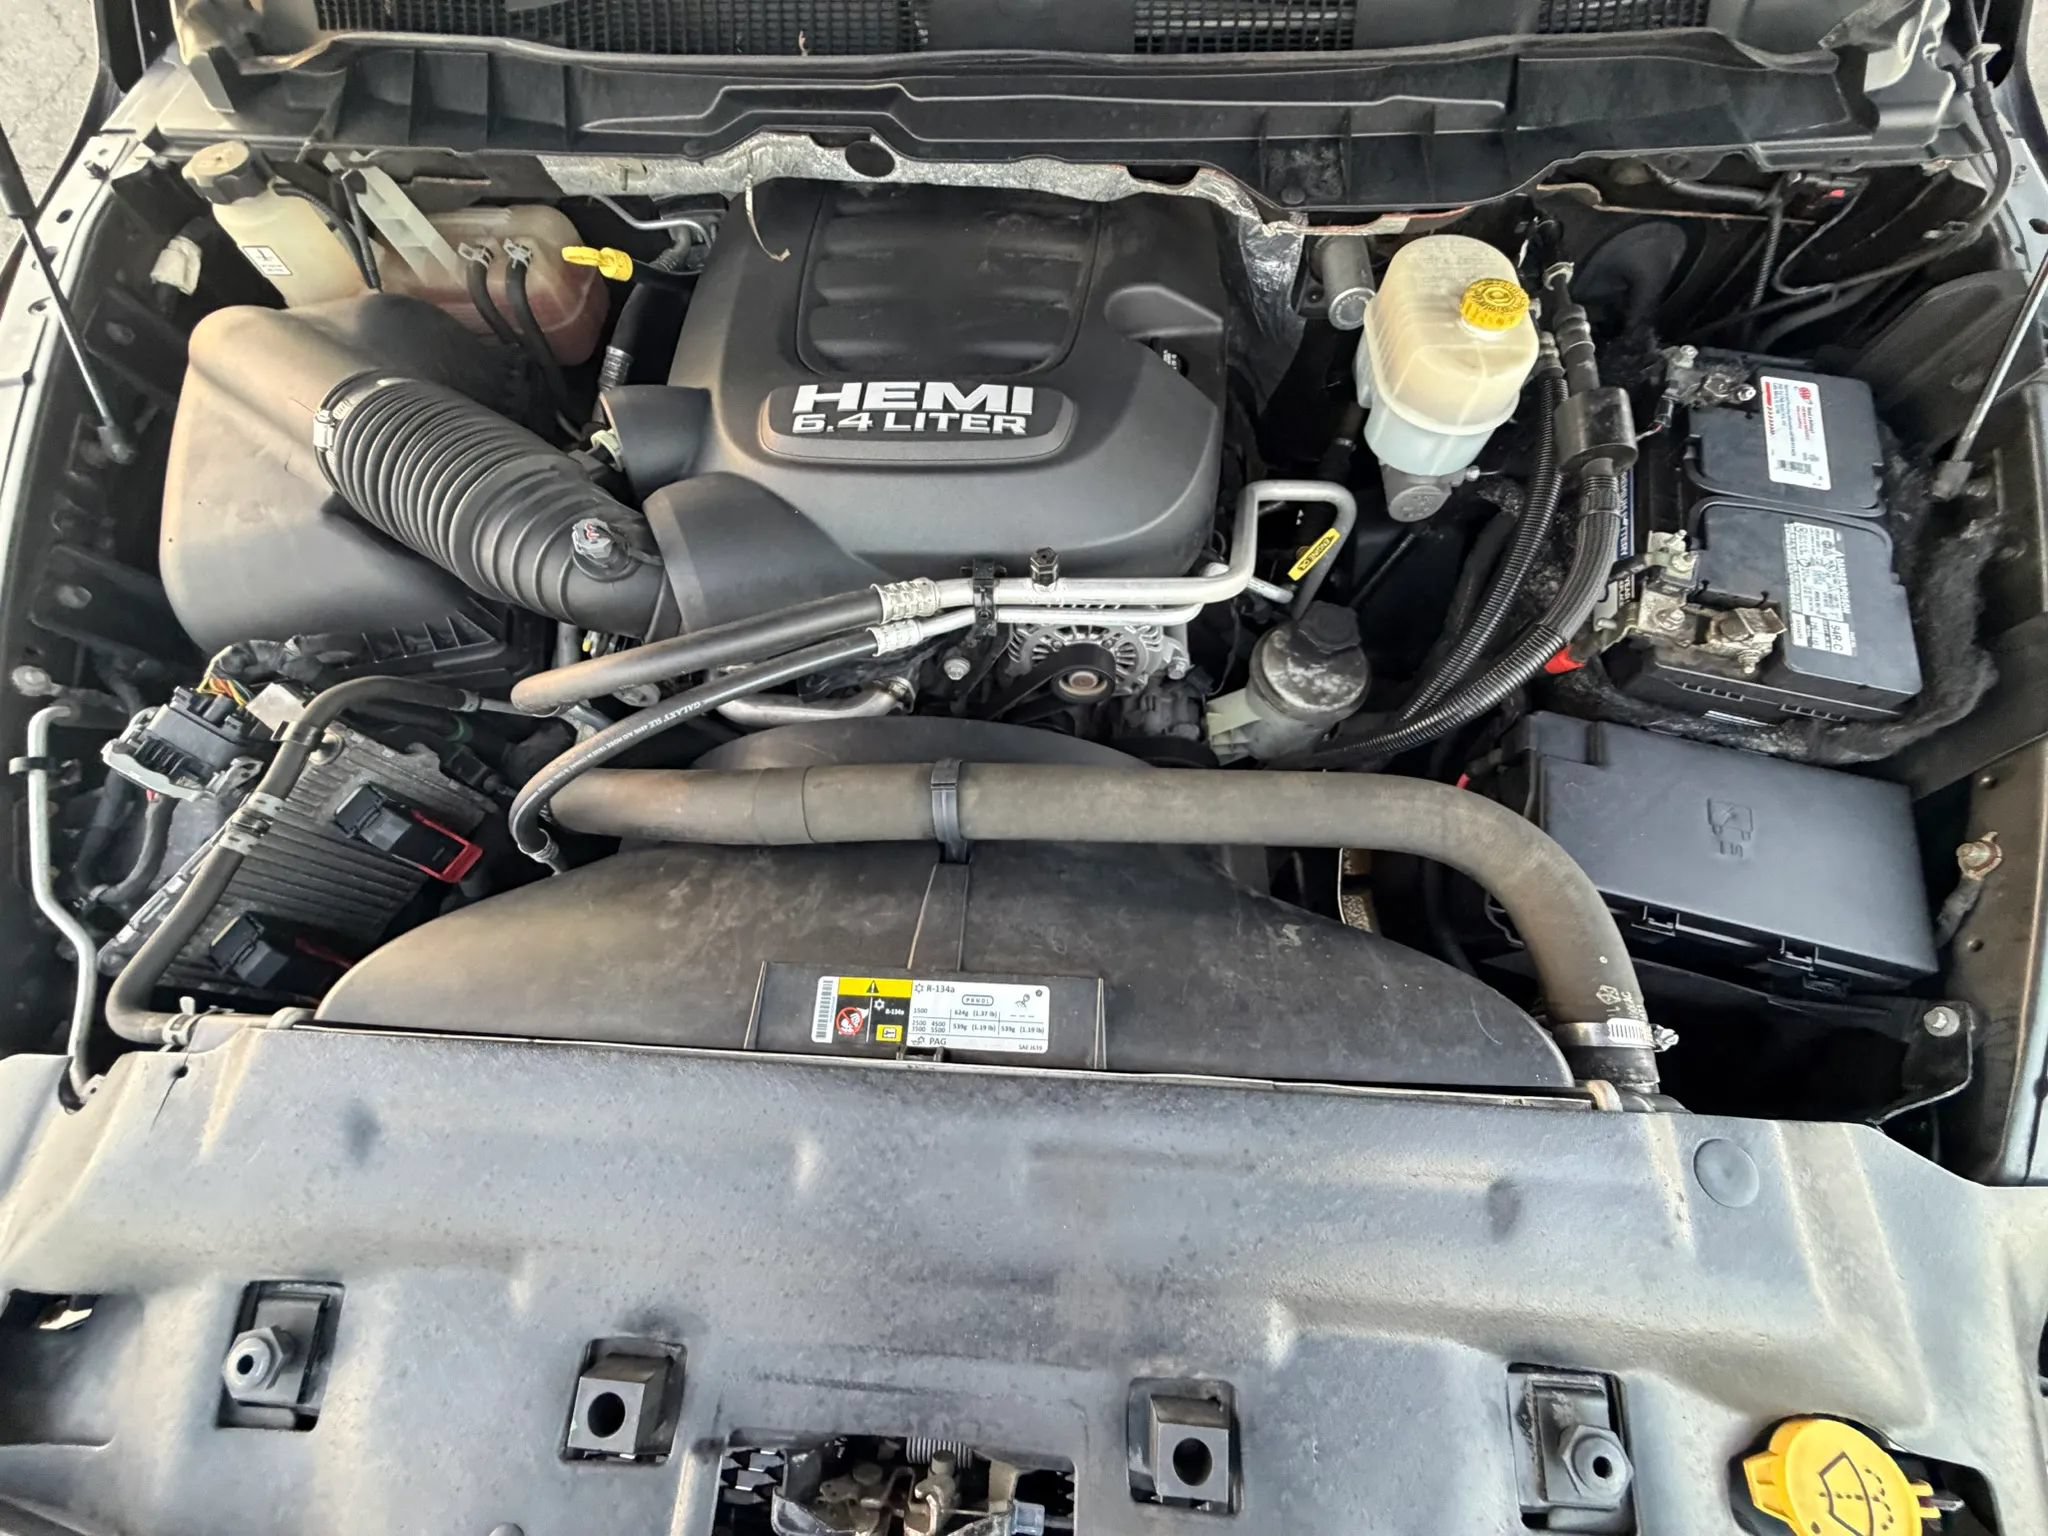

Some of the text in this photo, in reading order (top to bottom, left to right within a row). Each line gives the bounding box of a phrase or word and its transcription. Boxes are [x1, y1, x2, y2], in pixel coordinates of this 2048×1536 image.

[792, 381, 1034, 415] HEMI
[792, 412, 1027, 435] 6.4 LITER
[663, 701, 701, 722] GALAXY
[926, 984, 956, 993] R-134a
[929, 1037, 947, 1045] PAG
